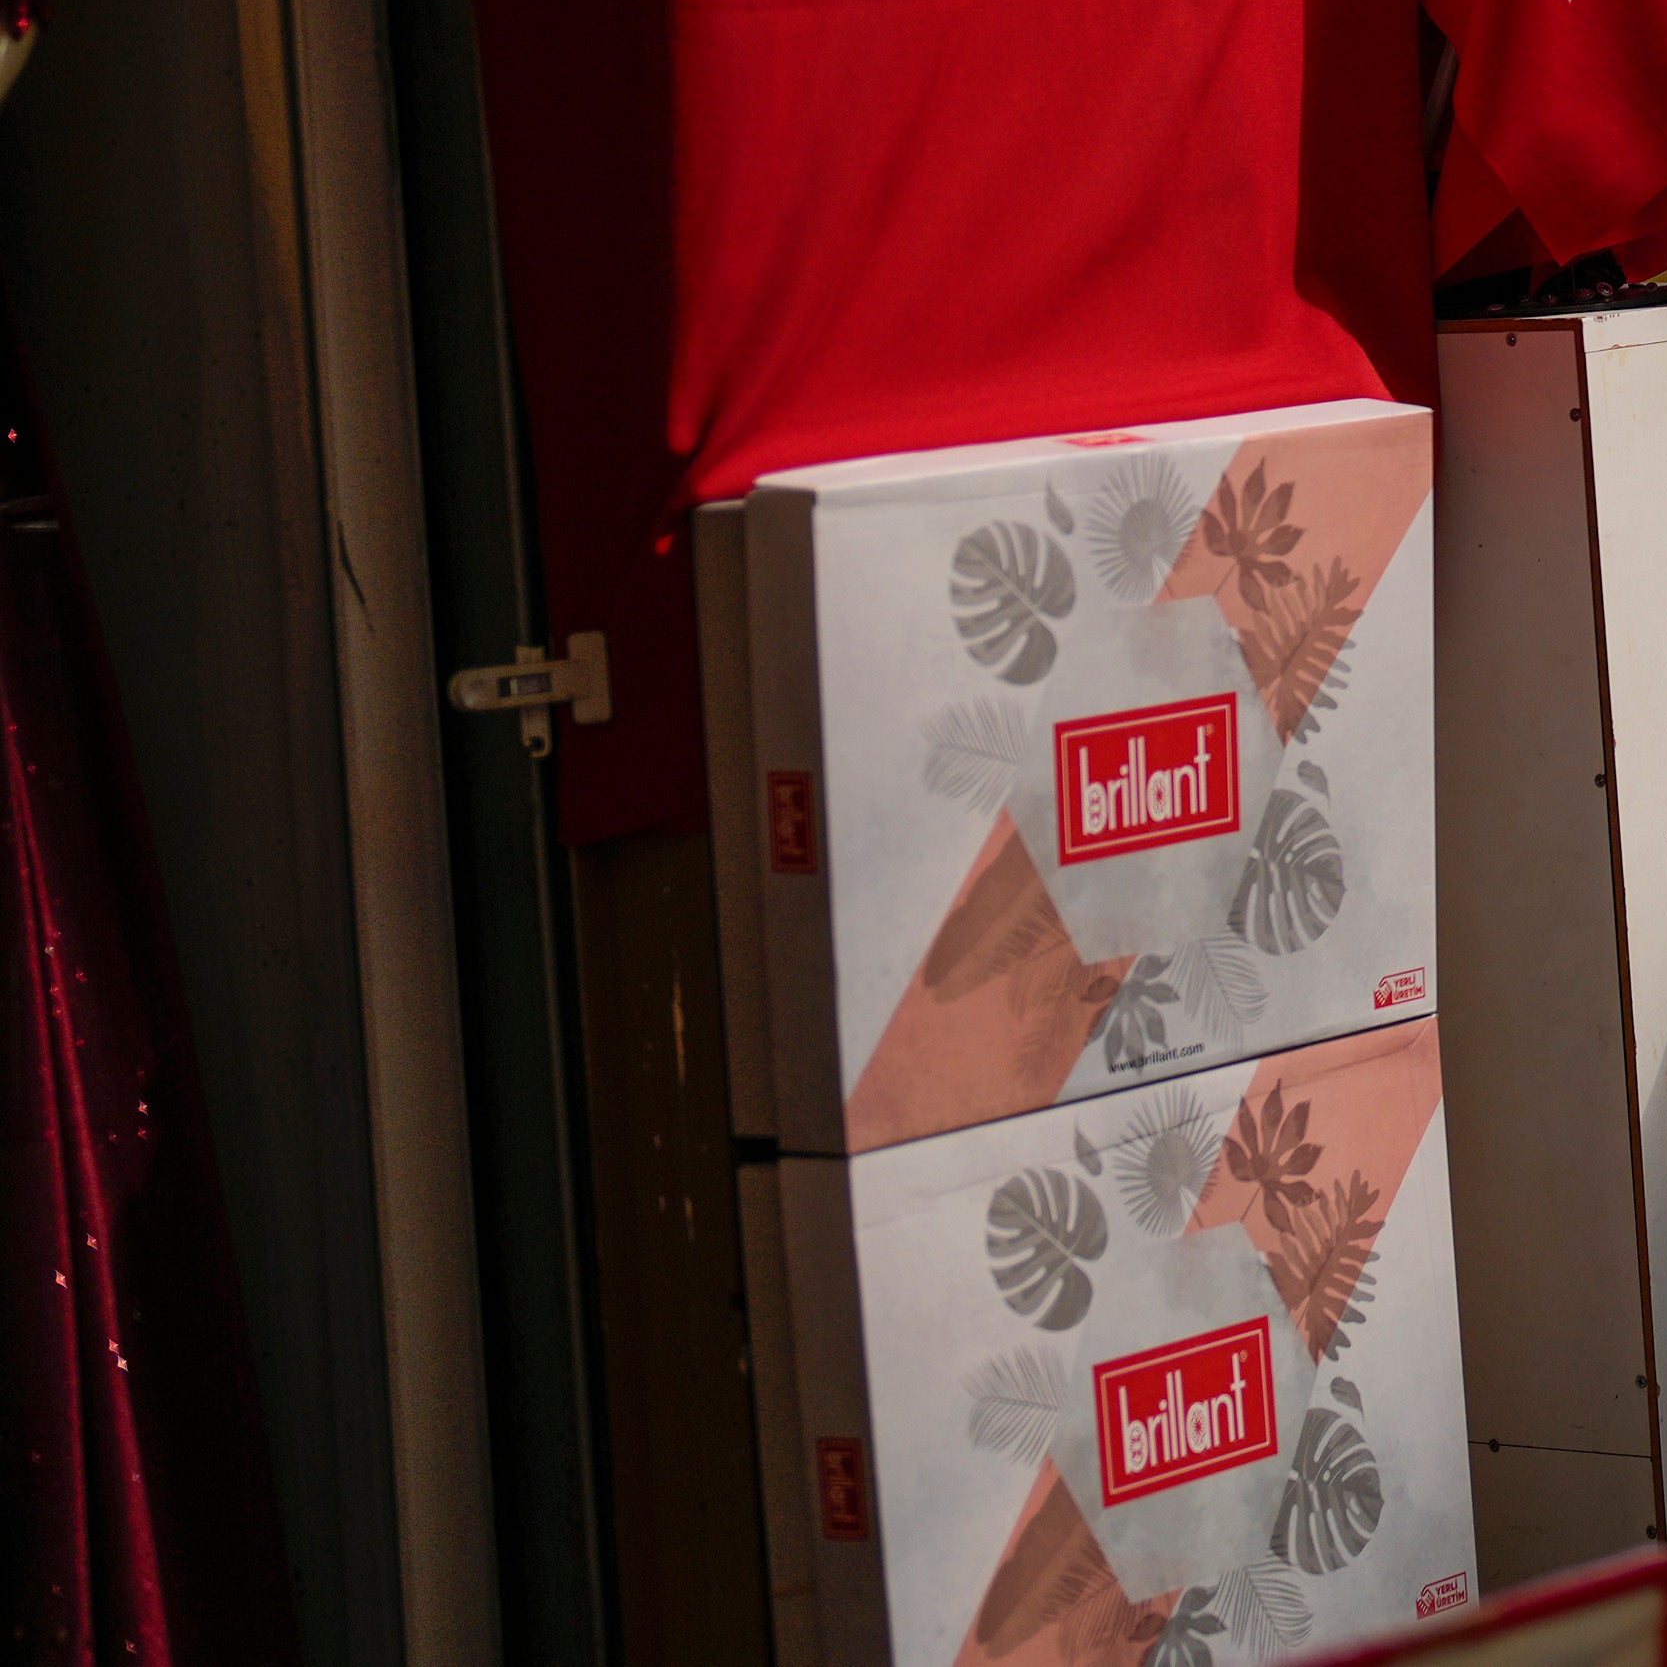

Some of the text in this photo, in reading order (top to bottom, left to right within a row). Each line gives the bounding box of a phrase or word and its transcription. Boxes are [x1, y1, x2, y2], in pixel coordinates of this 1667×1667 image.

[1079, 725, 1211, 836] brillant
[1109, 1042, 1205, 1075] www.brillant.com
[1118, 1352, 1247, 1475] brillant
[1437, 1589, 1465, 1609] ÜRETİM
